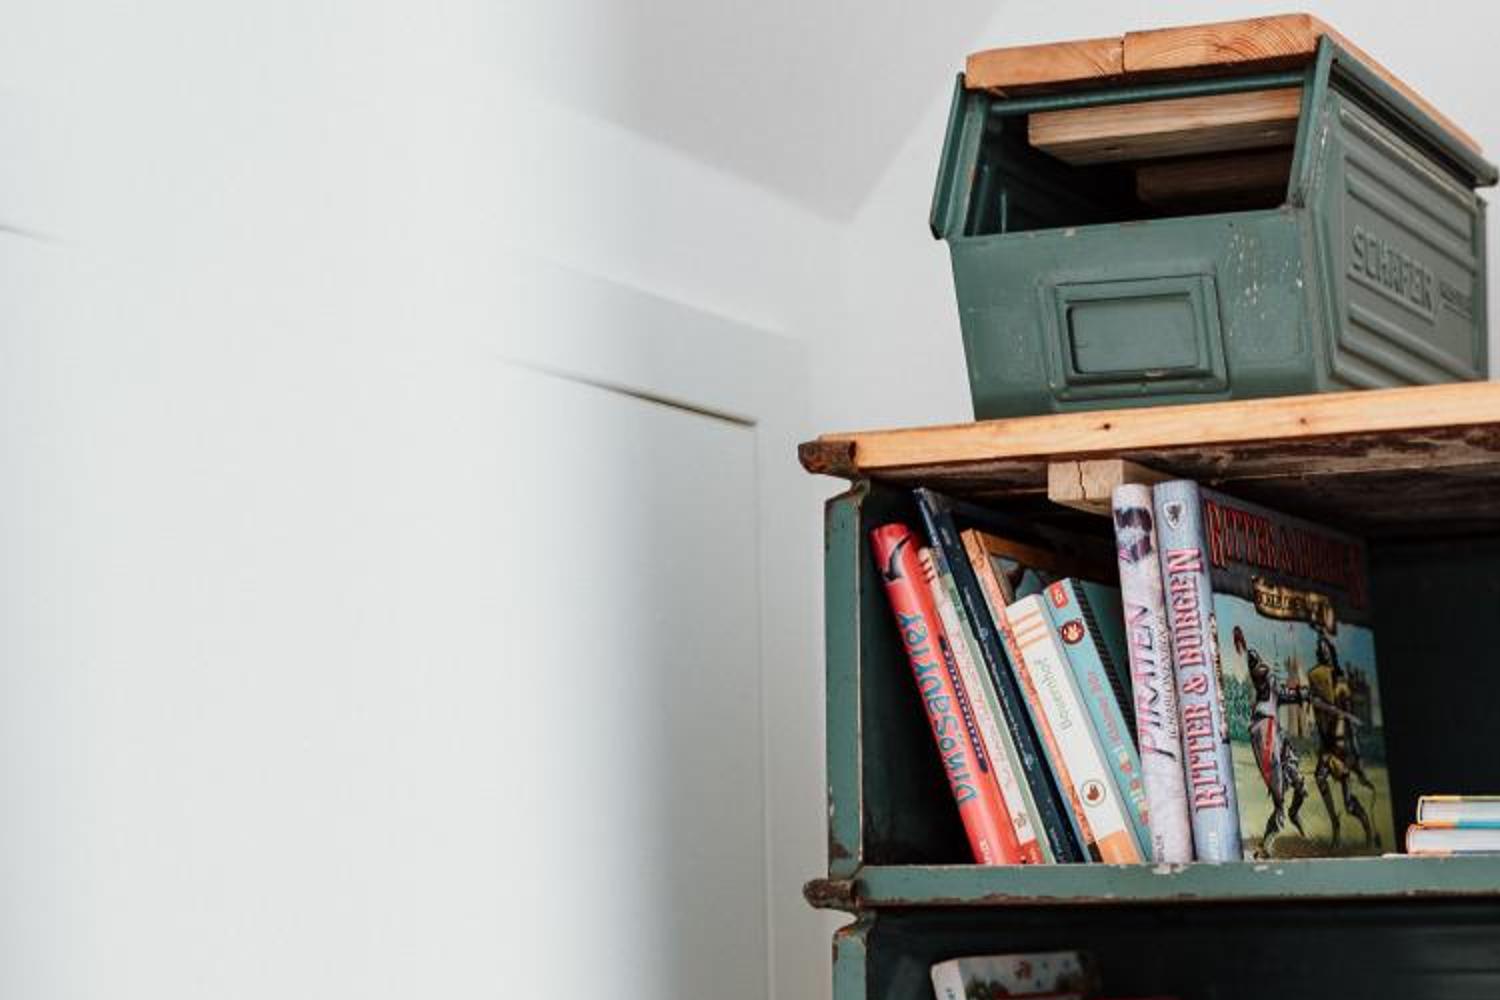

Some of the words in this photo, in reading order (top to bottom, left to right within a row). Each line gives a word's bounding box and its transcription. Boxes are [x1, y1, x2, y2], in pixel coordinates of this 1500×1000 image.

[1167, 547, 1207, 669] BURGEN
[1126, 603, 1176, 762] PIRATEN
[1184, 673, 1208, 696] &
[1183, 703, 1230, 811] RITTER
